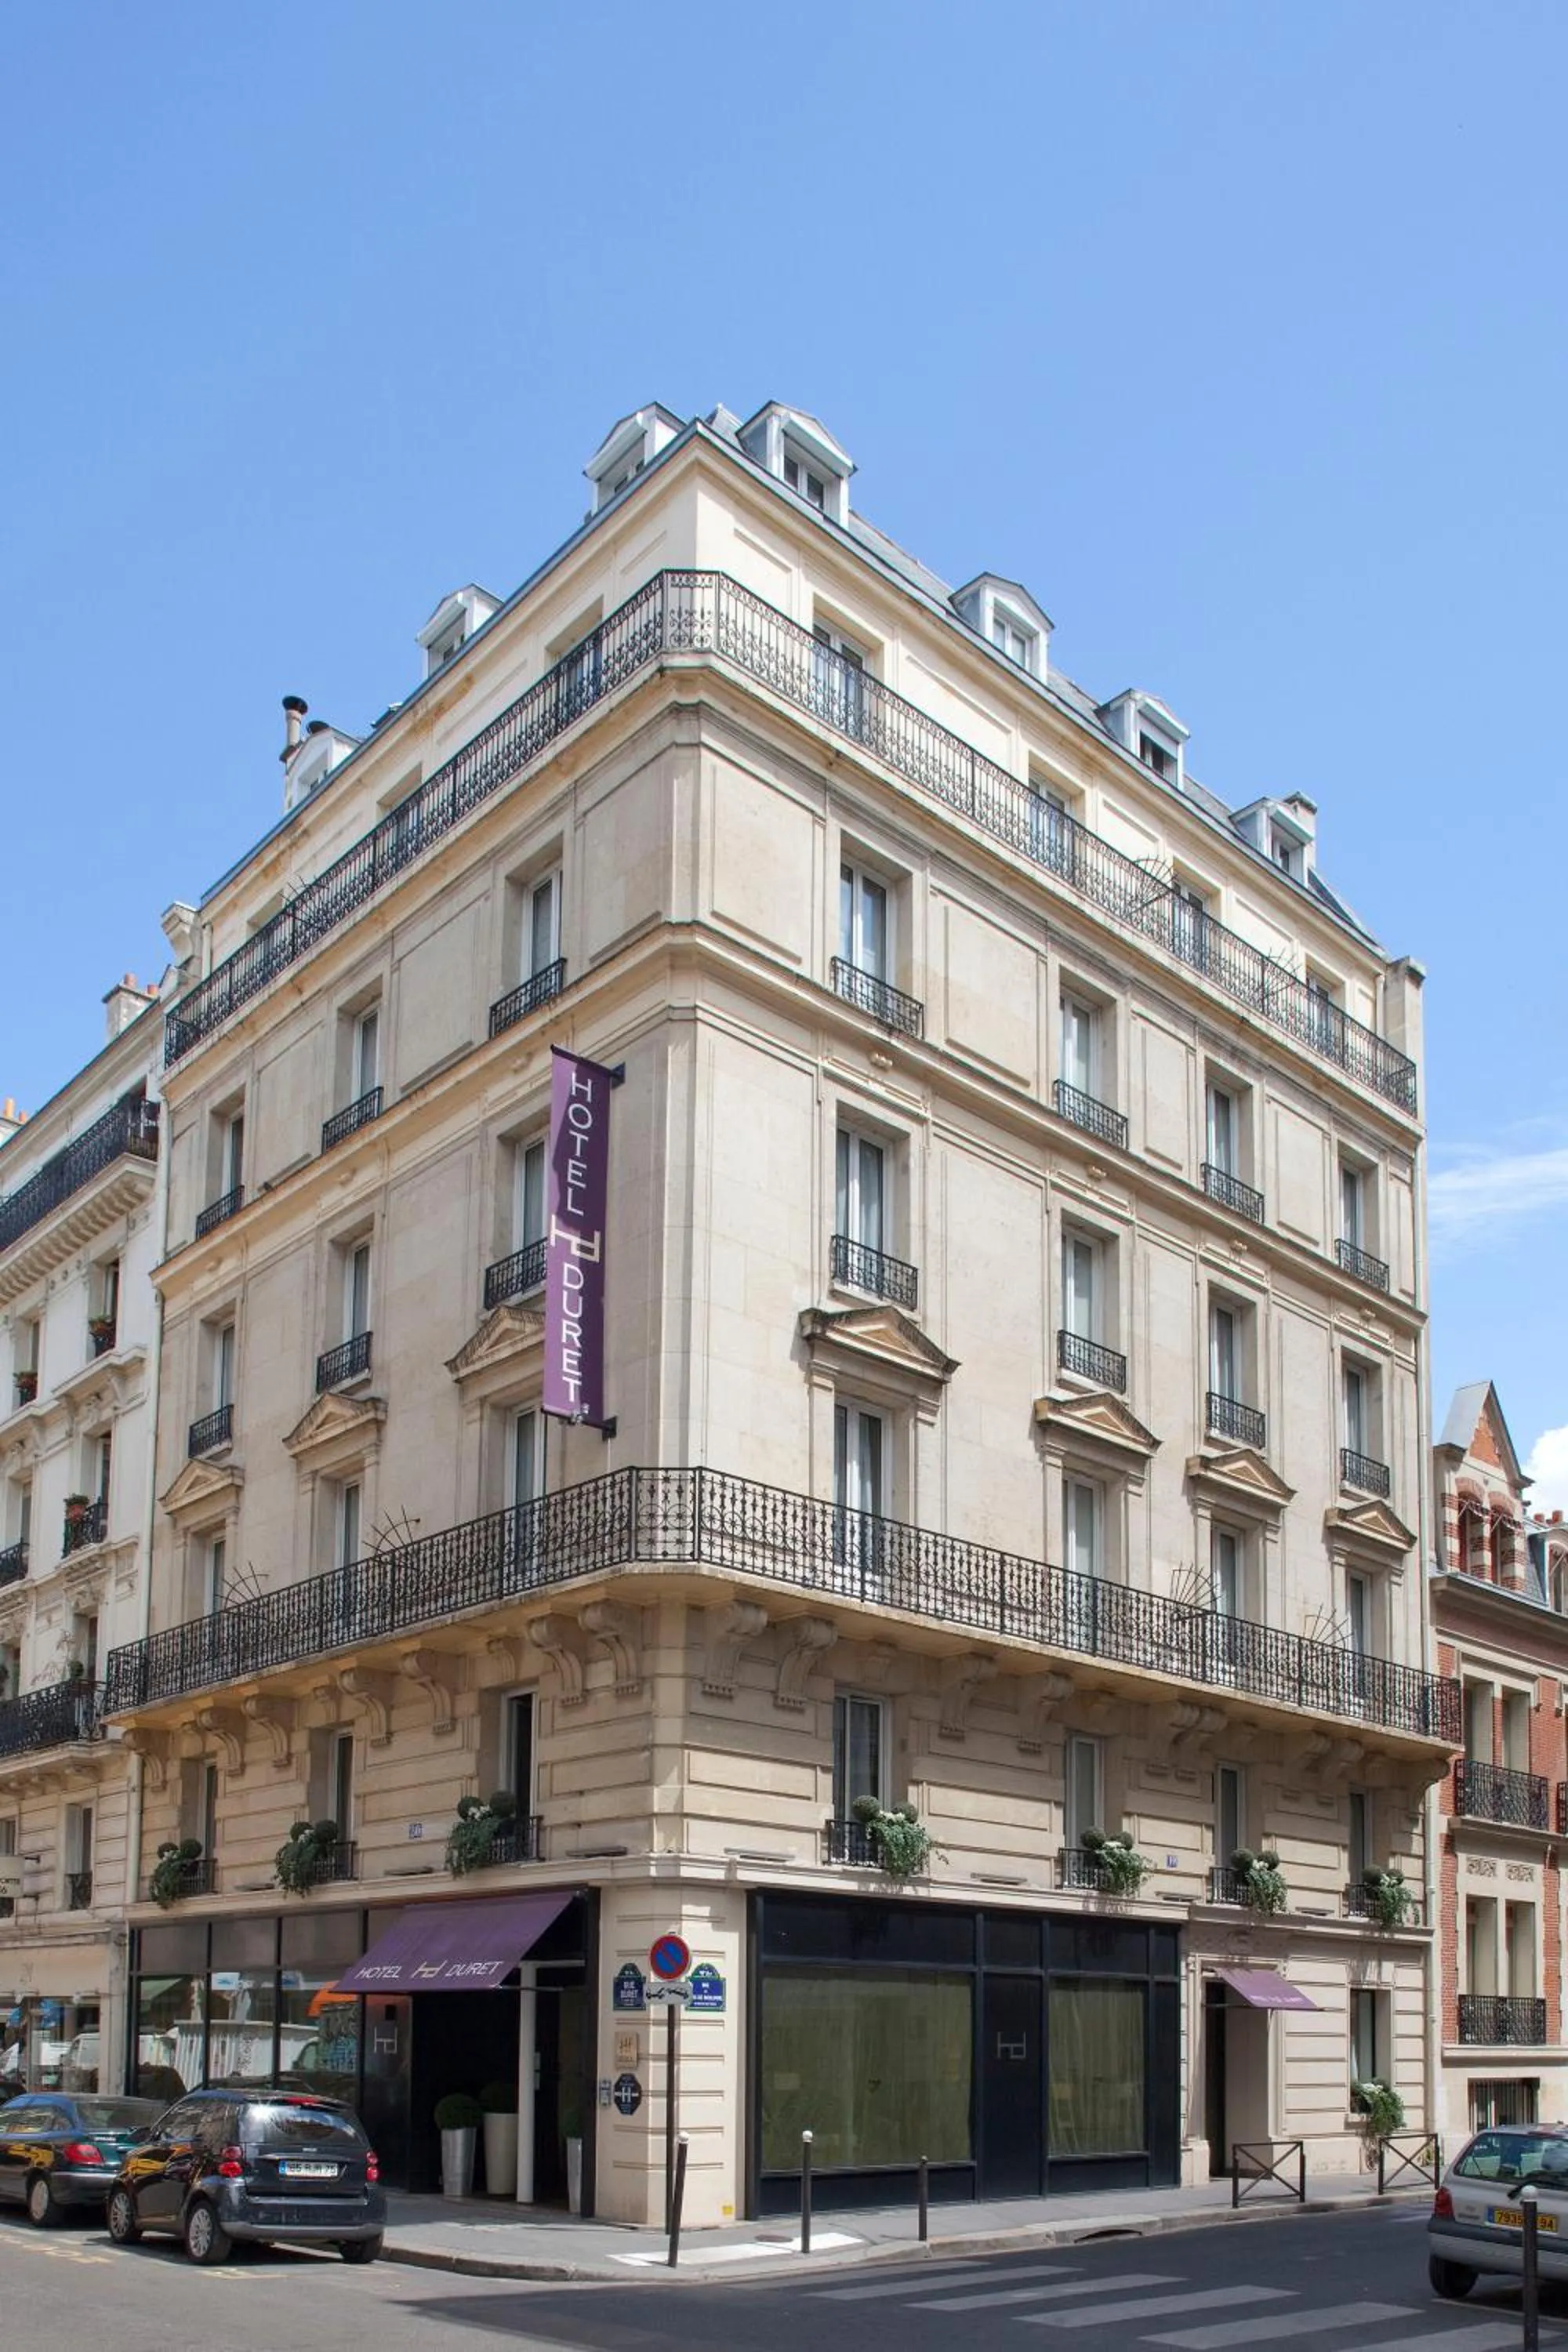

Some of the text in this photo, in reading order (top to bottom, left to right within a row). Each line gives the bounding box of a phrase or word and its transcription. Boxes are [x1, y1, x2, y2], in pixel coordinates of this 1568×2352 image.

[566, 1071, 593, 1217] HOTEL
[561, 1262, 585, 1403] DURET
[354, 1965, 402, 1980] HOTEL
[445, 1960, 505, 1977] DURET
[622, 2086, 631, 2103] H
[1539, 2217, 1554, 2229] 94
